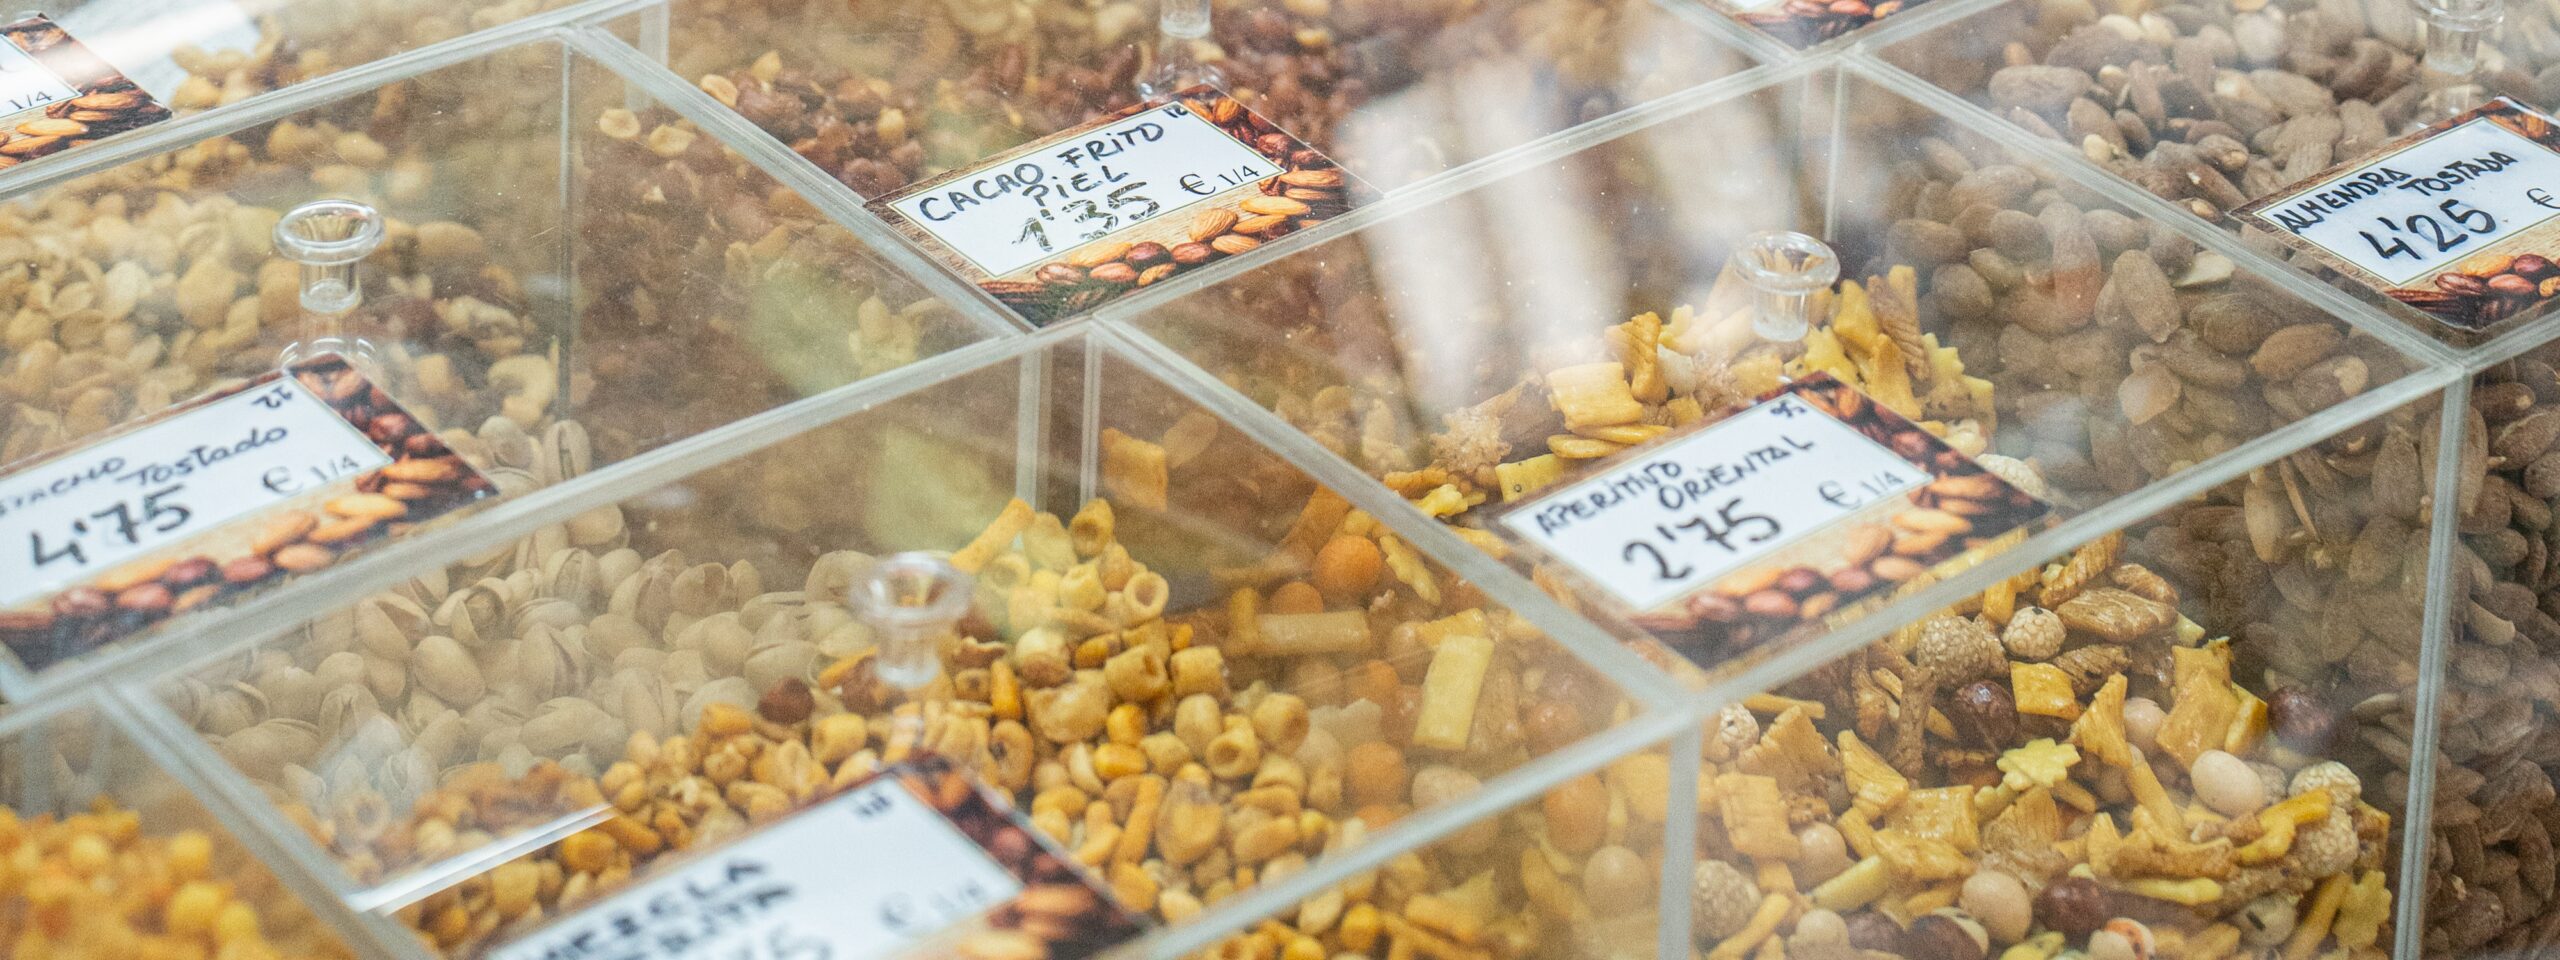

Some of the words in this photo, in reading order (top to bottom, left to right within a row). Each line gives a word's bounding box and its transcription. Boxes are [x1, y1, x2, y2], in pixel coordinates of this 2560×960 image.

[919, 163, 1044, 222] CACAO
[1179, 173, 1216, 196] €
[1217, 165, 1260, 186] 1/4
[2397, 151, 2519, 196] TOSTADA
[2359, 198, 2496, 260] 4'25
[30, 484, 191, 567] 4'75
[262, 465, 302, 494] €
[309, 453, 360, 482] 1/4
[1622, 498, 1781, 580] 2'75
[1860, 471, 1905, 497] 1/4
